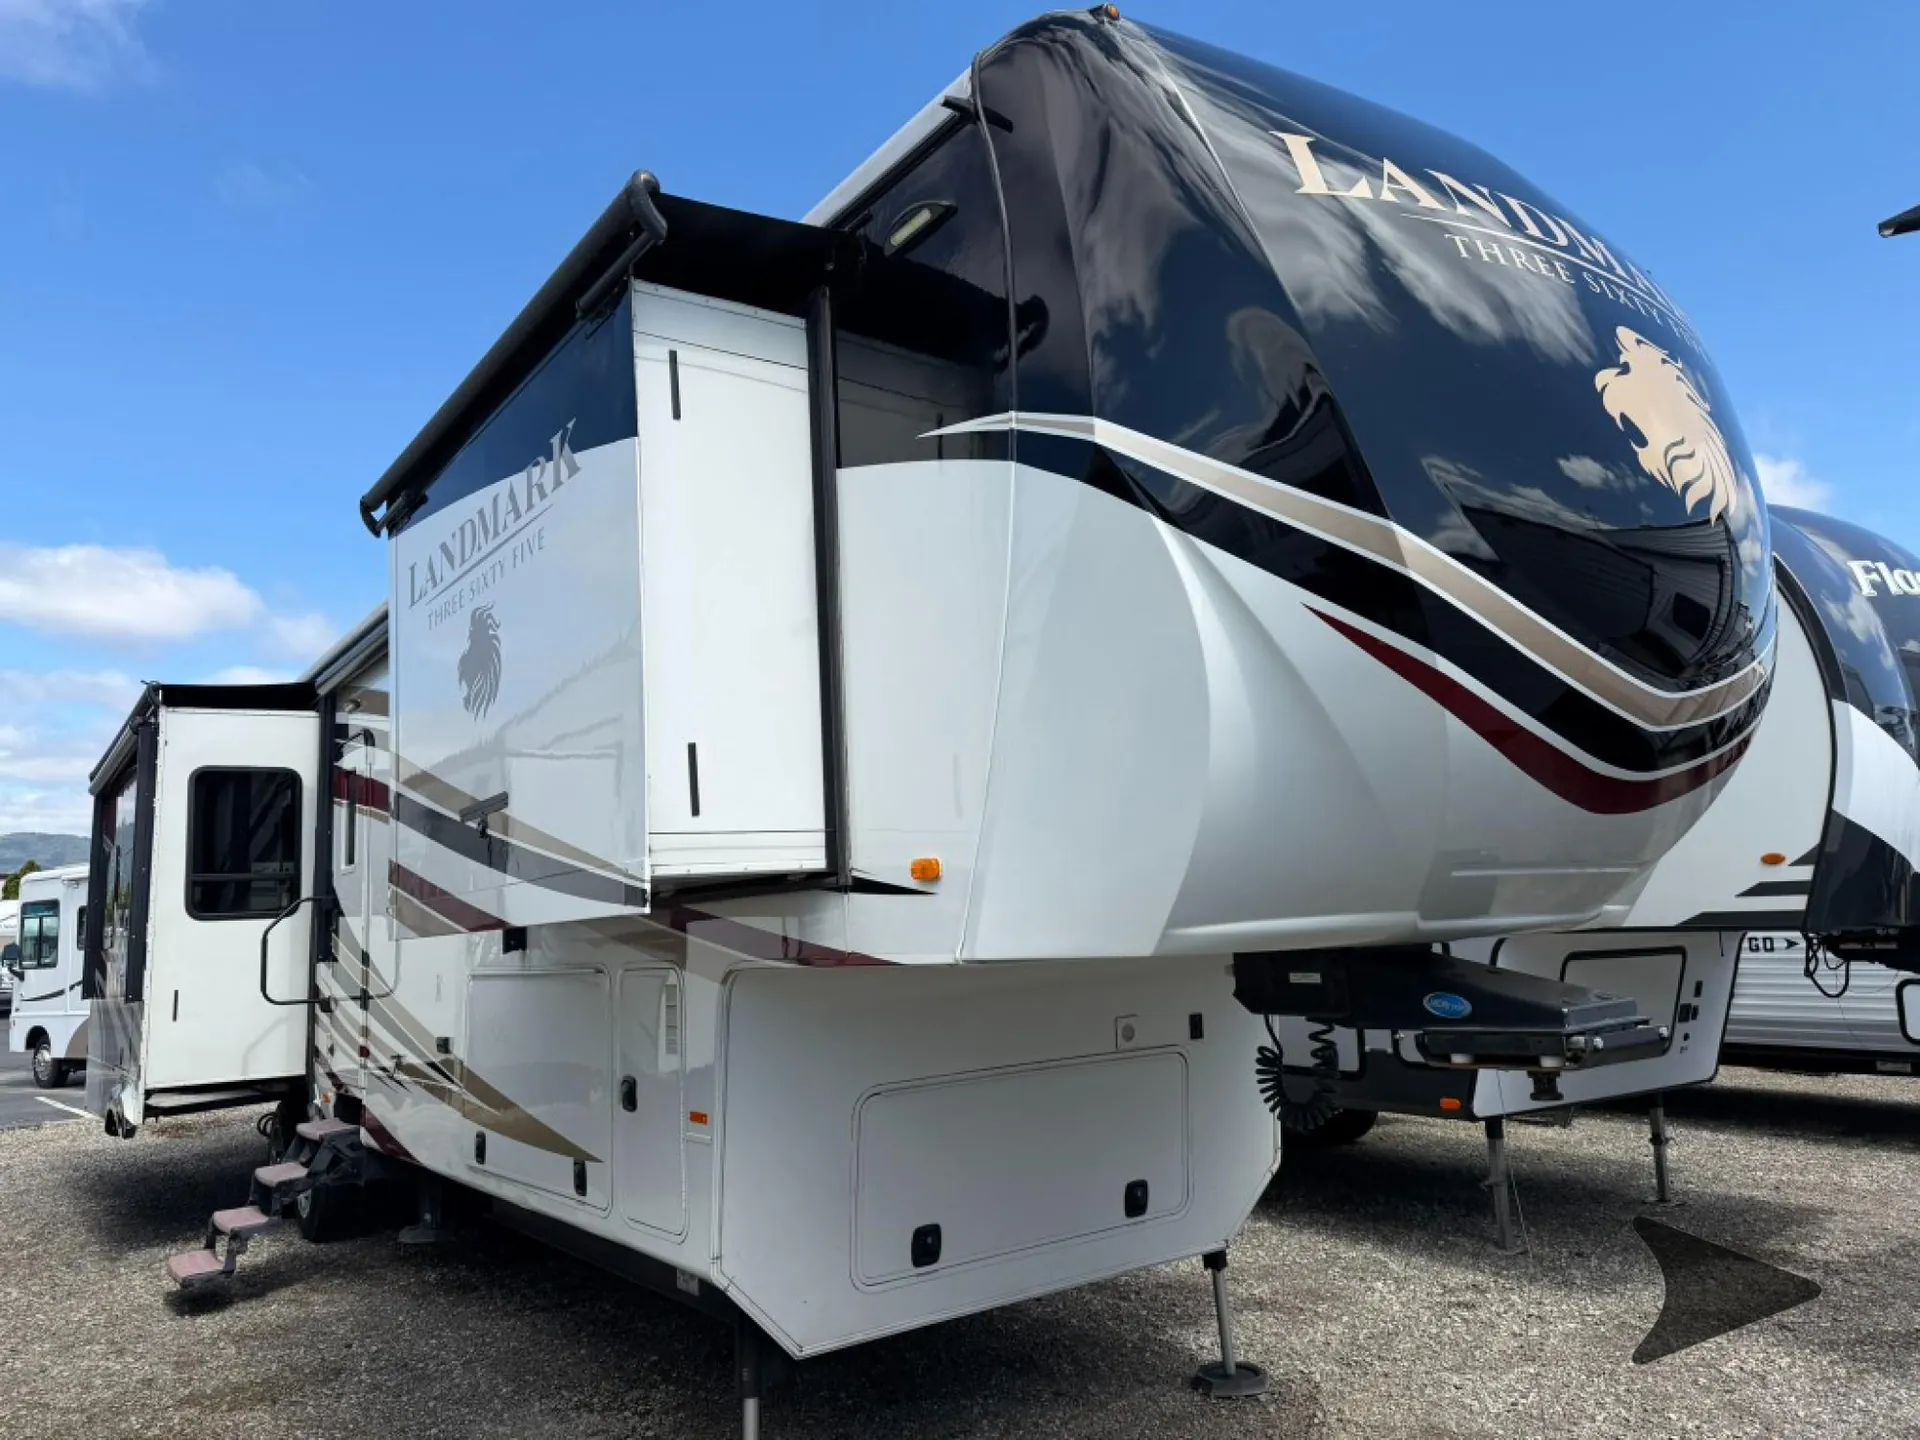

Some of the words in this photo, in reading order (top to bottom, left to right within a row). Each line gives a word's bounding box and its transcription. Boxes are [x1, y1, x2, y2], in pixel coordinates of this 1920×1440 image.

[1444, 233, 1576, 284] THREE
[1582, 271, 1663, 327] SIXTY
[408, 417, 582, 608] LANDMARK
[428, 588, 465, 631] THREE
[468, 555, 505, 602] SIXTY
[511, 526, 545, 569] FIVE
[1846, 560, 1920, 597] Fla
[1748, 937, 1775, 953] GO
